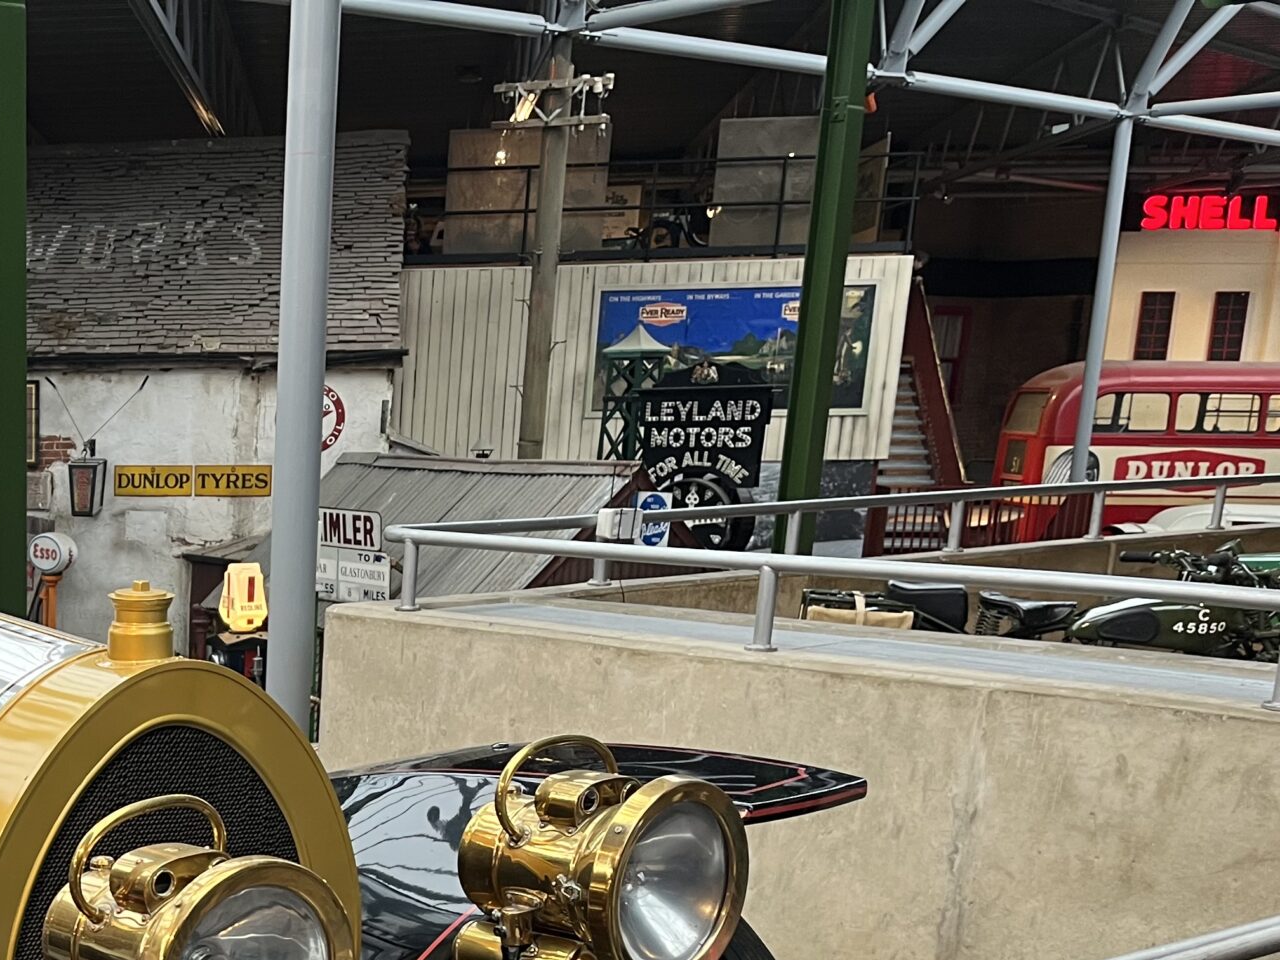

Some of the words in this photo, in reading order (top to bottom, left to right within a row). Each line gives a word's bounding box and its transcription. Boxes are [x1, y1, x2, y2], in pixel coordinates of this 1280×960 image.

[1141, 195, 1277, 231] SHELL
[645, 400, 762, 421] LEYLAND
[327, 422, 344, 445] OIL
[650, 426, 752, 448] MOTORS
[648, 456, 678, 484] FOR
[682, 450, 712, 467] ALL
[716, 453, 750, 484] TIME
[117, 473, 190, 489] DUNLOP
[197, 473, 268, 489] TYRES
[321, 511, 375, 547] IMLER
[358, 553, 371, 562] TO
[340, 566, 385, 582] GLASTONBURY
[1198, 608, 1211, 621] C
[1172, 621, 1227, 635] 45850
